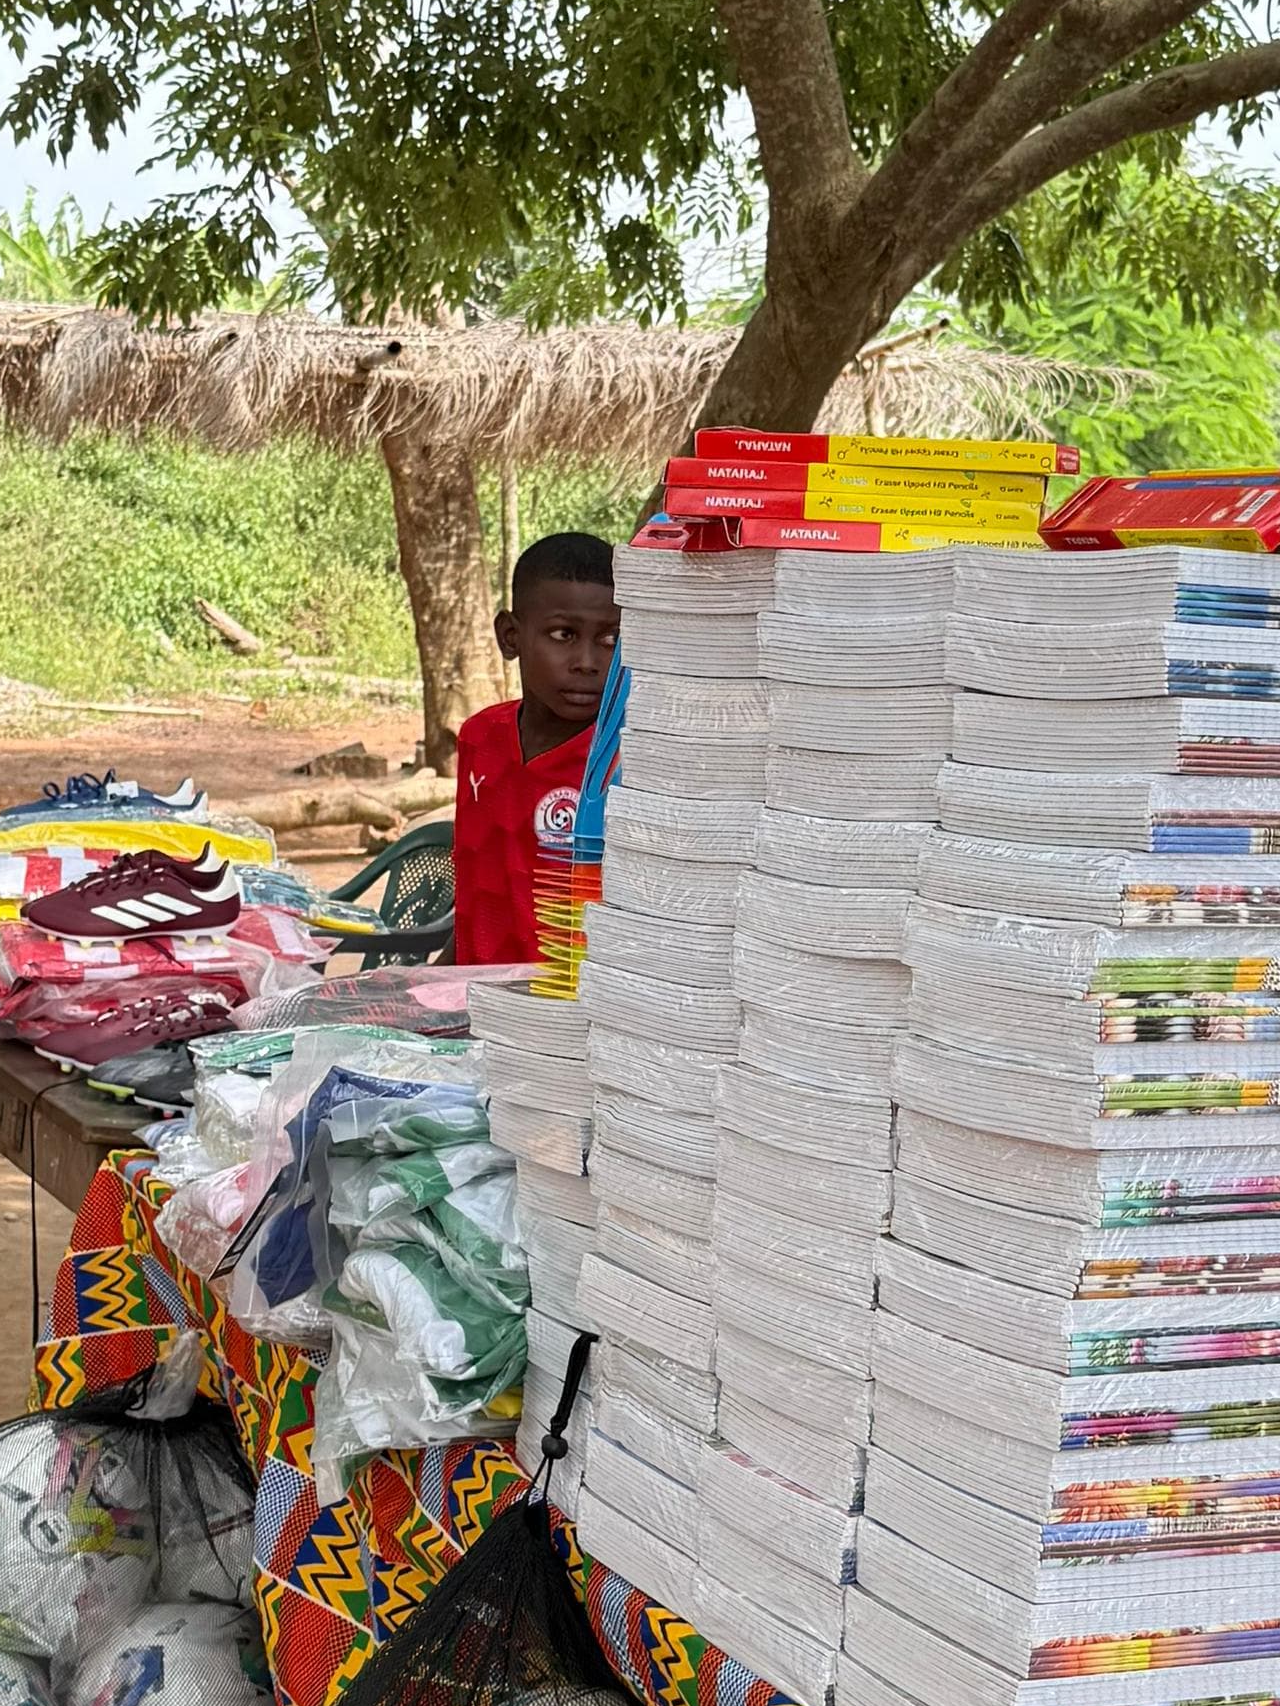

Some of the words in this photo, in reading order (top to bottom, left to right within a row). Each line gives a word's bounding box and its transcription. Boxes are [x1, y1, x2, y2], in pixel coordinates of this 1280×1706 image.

[875, 478, 901, 486] Eraser
[948, 482, 979, 491] Pencils
[871, 507, 897, 515] Eraser
[945, 509, 975, 518] Pencils
